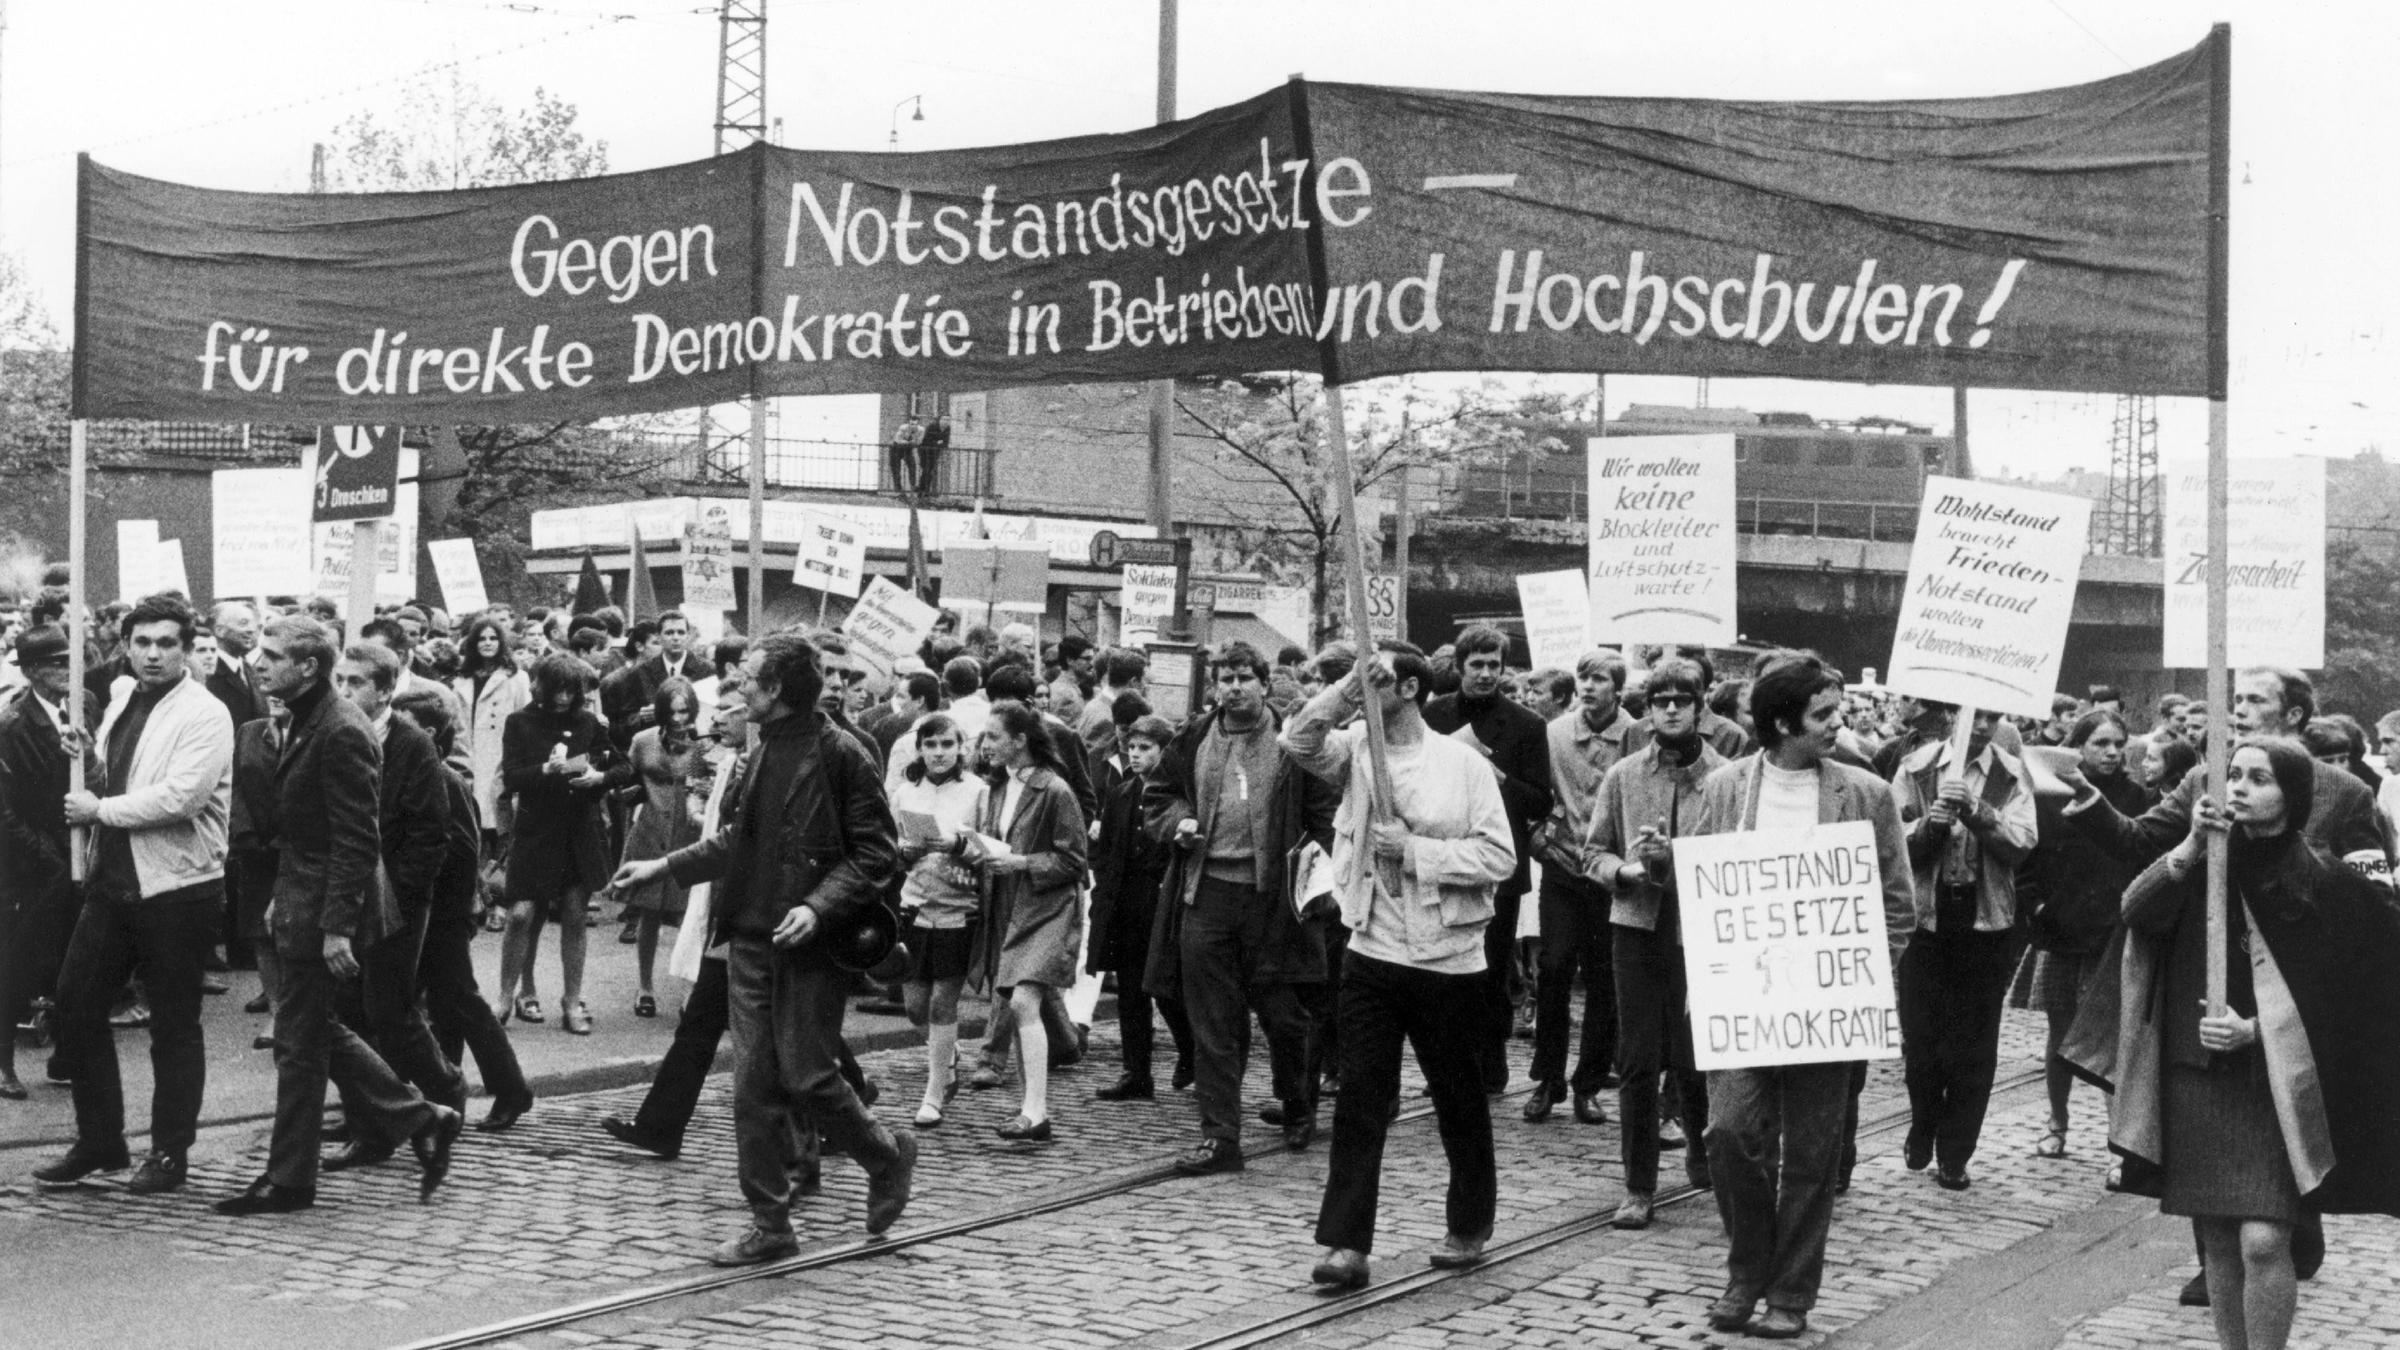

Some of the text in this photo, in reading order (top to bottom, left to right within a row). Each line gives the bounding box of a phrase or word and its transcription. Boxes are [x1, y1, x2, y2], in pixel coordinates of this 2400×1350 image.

[511, 214, 717, 302] Gegen
[783, 137, 1373, 268] Notstandsgesetze
[198, 248, 2028, 395] für direkte Demokratie in Betrieben und Hochschulen!
[1601, 456, 1701, 478] Wir wollen
[317, 481, 388, 508] 3 Droschken
[1614, 481, 1695, 511] keine
[1598, 515, 1720, 540] Blockleiter
[1934, 494, 2060, 532] Wohlstand
[1633, 541, 1674, 557] und
[1938, 521, 2018, 550] braucht
[1127, 567, 1175, 589] Soldaten
[1916, 573, 2038, 614] Notstand
[1919, 605, 1985, 630] wollen
[1900, 626, 1918, 643] die
[1694, 844, 1873, 899] NOTSTANDS
[1714, 896, 1870, 944] GESETZE
[1816, 947, 1876, 989] DER
[1708, 1006, 1902, 1053] DEMOKRATIE
